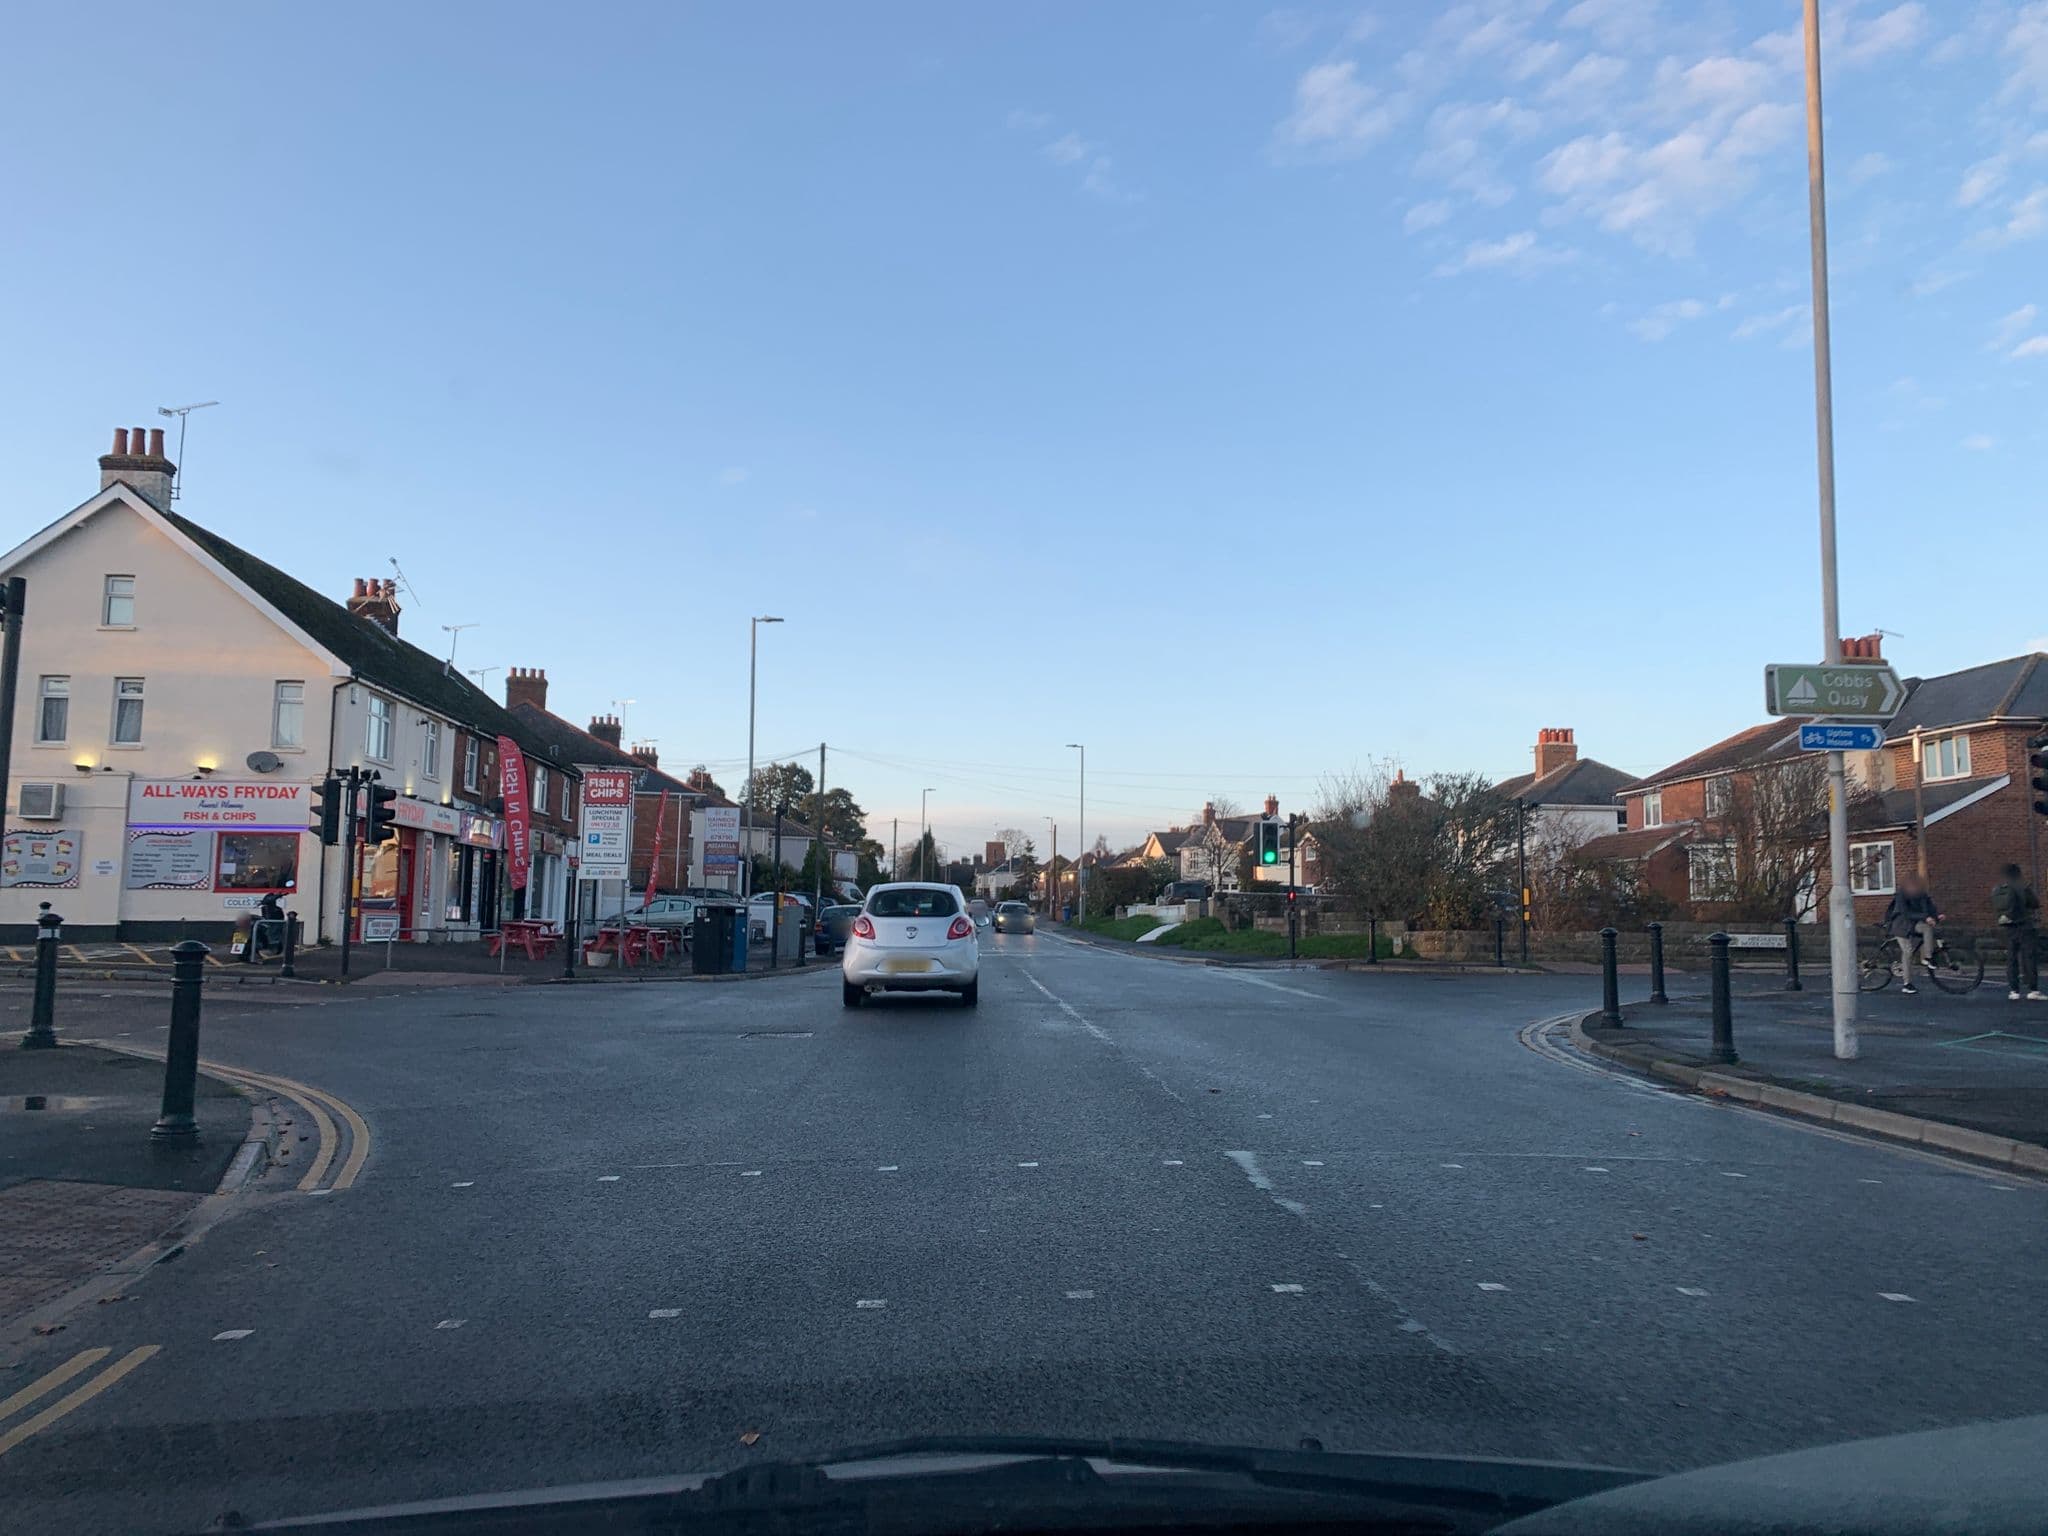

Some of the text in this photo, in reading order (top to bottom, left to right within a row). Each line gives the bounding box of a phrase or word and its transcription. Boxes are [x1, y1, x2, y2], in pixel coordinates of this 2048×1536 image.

[1821, 671, 1873, 688] Cobbs
[1828, 690, 1869, 709] Quay
[588, 778, 625, 788] FISH &
[143, 785, 300, 799] ALL-WAYS FRYDAY
[590, 788, 624, 799] CHIPS
[183, 811, 257, 821] FISH & CHIPS
